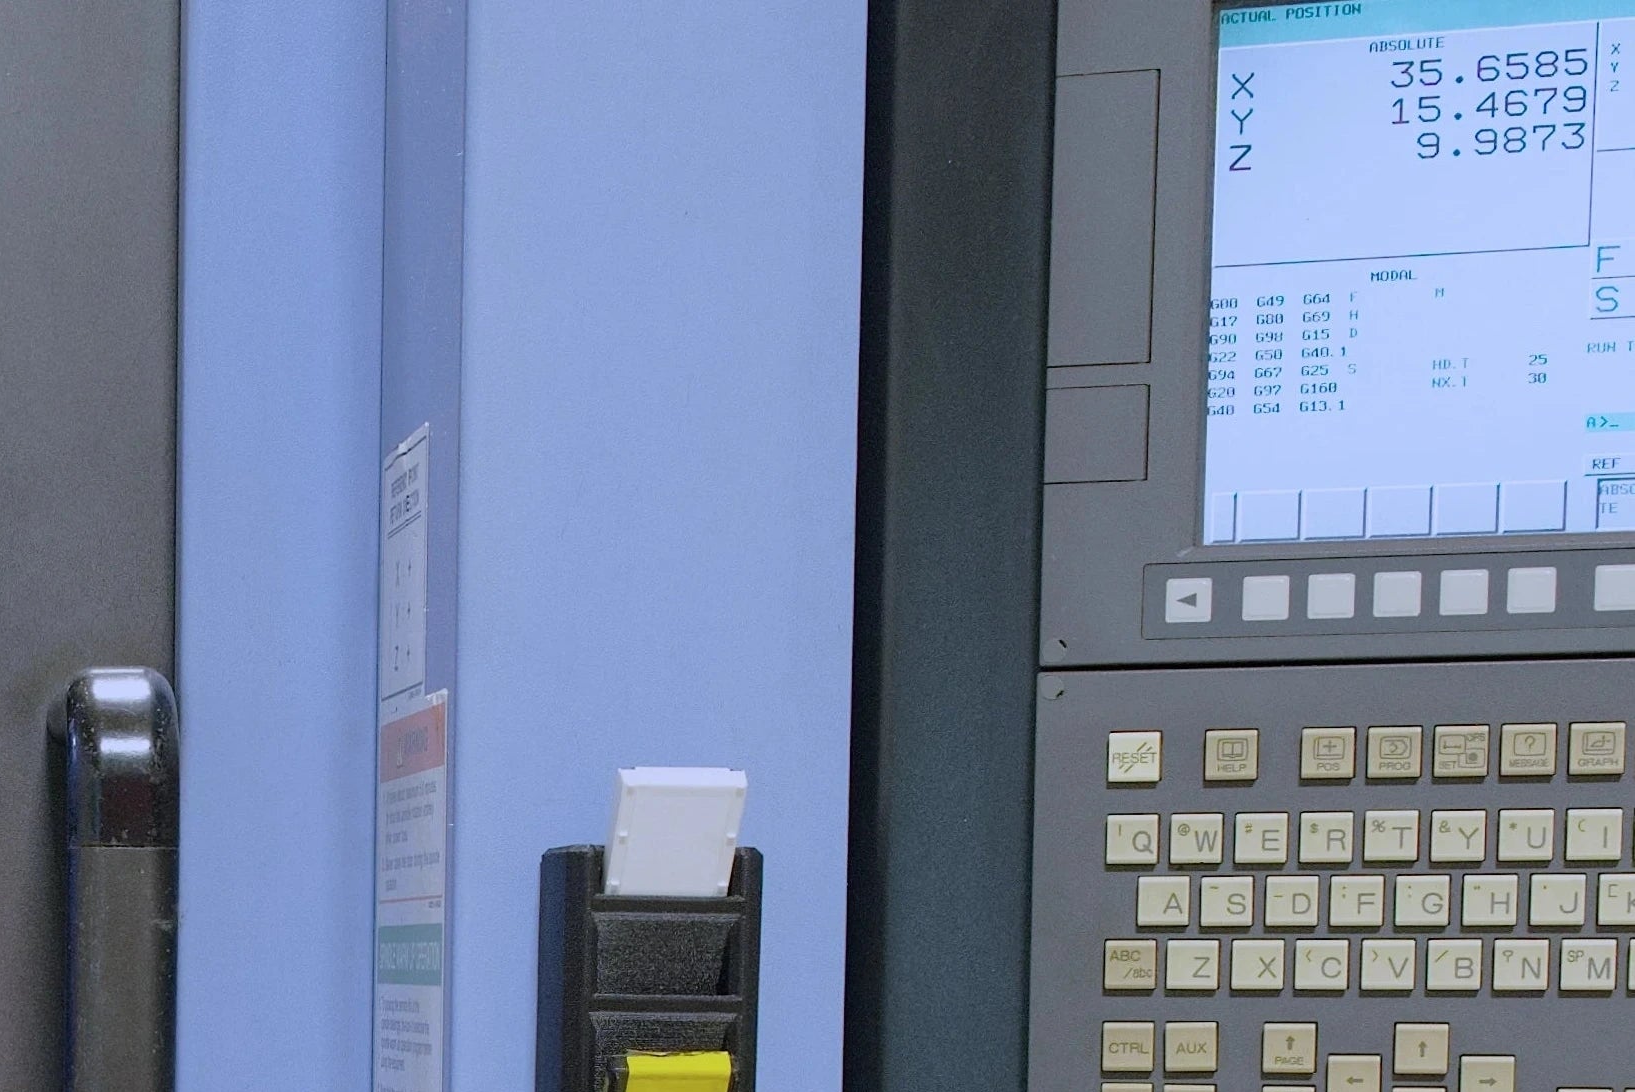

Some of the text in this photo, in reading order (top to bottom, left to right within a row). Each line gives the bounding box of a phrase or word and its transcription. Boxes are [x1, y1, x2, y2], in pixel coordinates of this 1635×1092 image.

[1221, 3, 1362, 25] ACTUAL POSITION
[1369, 36, 1445, 53] ABSOLUTE
[1231, 48, 1588, 99] X 35.6585
[1231, 85, 1587, 135] Y 15.4679
[1229, 122, 1586, 172] Z 9.9873
[1596, 245, 1621, 273] F
[1370, 269, 1417, 283] MODAL
[1256, 295, 1285, 307] G49
[1595, 286, 1619, 313] S
[1302, 329, 1330, 341] G15
[1528, 354, 1548, 366] 25
[1528, 372, 1547, 384] 30
[1592, 457, 1621, 470] REF
[1112, 751, 1157, 765] RESET
[1217, 762, 1247, 772] HELP
[1316, 762, 1341, 772] POS
[1378, 761, 1411, 771] PROG
[1577, 757, 1619, 767] GRAPH
[1132, 830, 1153, 854] Q
[1195, 830, 1218, 852] W
[1261, 829, 1280, 851] E
[1326, 829, 1346, 851] R
[1391, 826, 1413, 849] T
[1458, 827, 1480, 850] Y
[1527, 826, 1546, 849] U
[1163, 892, 1183, 914] A
[1226, 893, 1247, 915] S
[1291, 893, 1311, 914] D
[1357, 893, 1376, 914] F
[1421, 892, 1443, 915] G
[1490, 892, 1510, 915] H
[1559, 891, 1578, 914] J
[1109, 950, 1141, 962] ABC
[1192, 956, 1211, 978] Z
[1257, 956, 1277, 978] X
[1321, 956, 1342, 978] C
[1388, 957, 1408, 979] V
[1454, 957, 1474, 979] B
[1521, 957, 1541, 979] N
[1587, 957, 1611, 980] M
[1108, 1042, 1150, 1055] CTRL
[1176, 1042, 1207, 1055] AUX
[1274, 1056, 1304, 1066] PAGE
